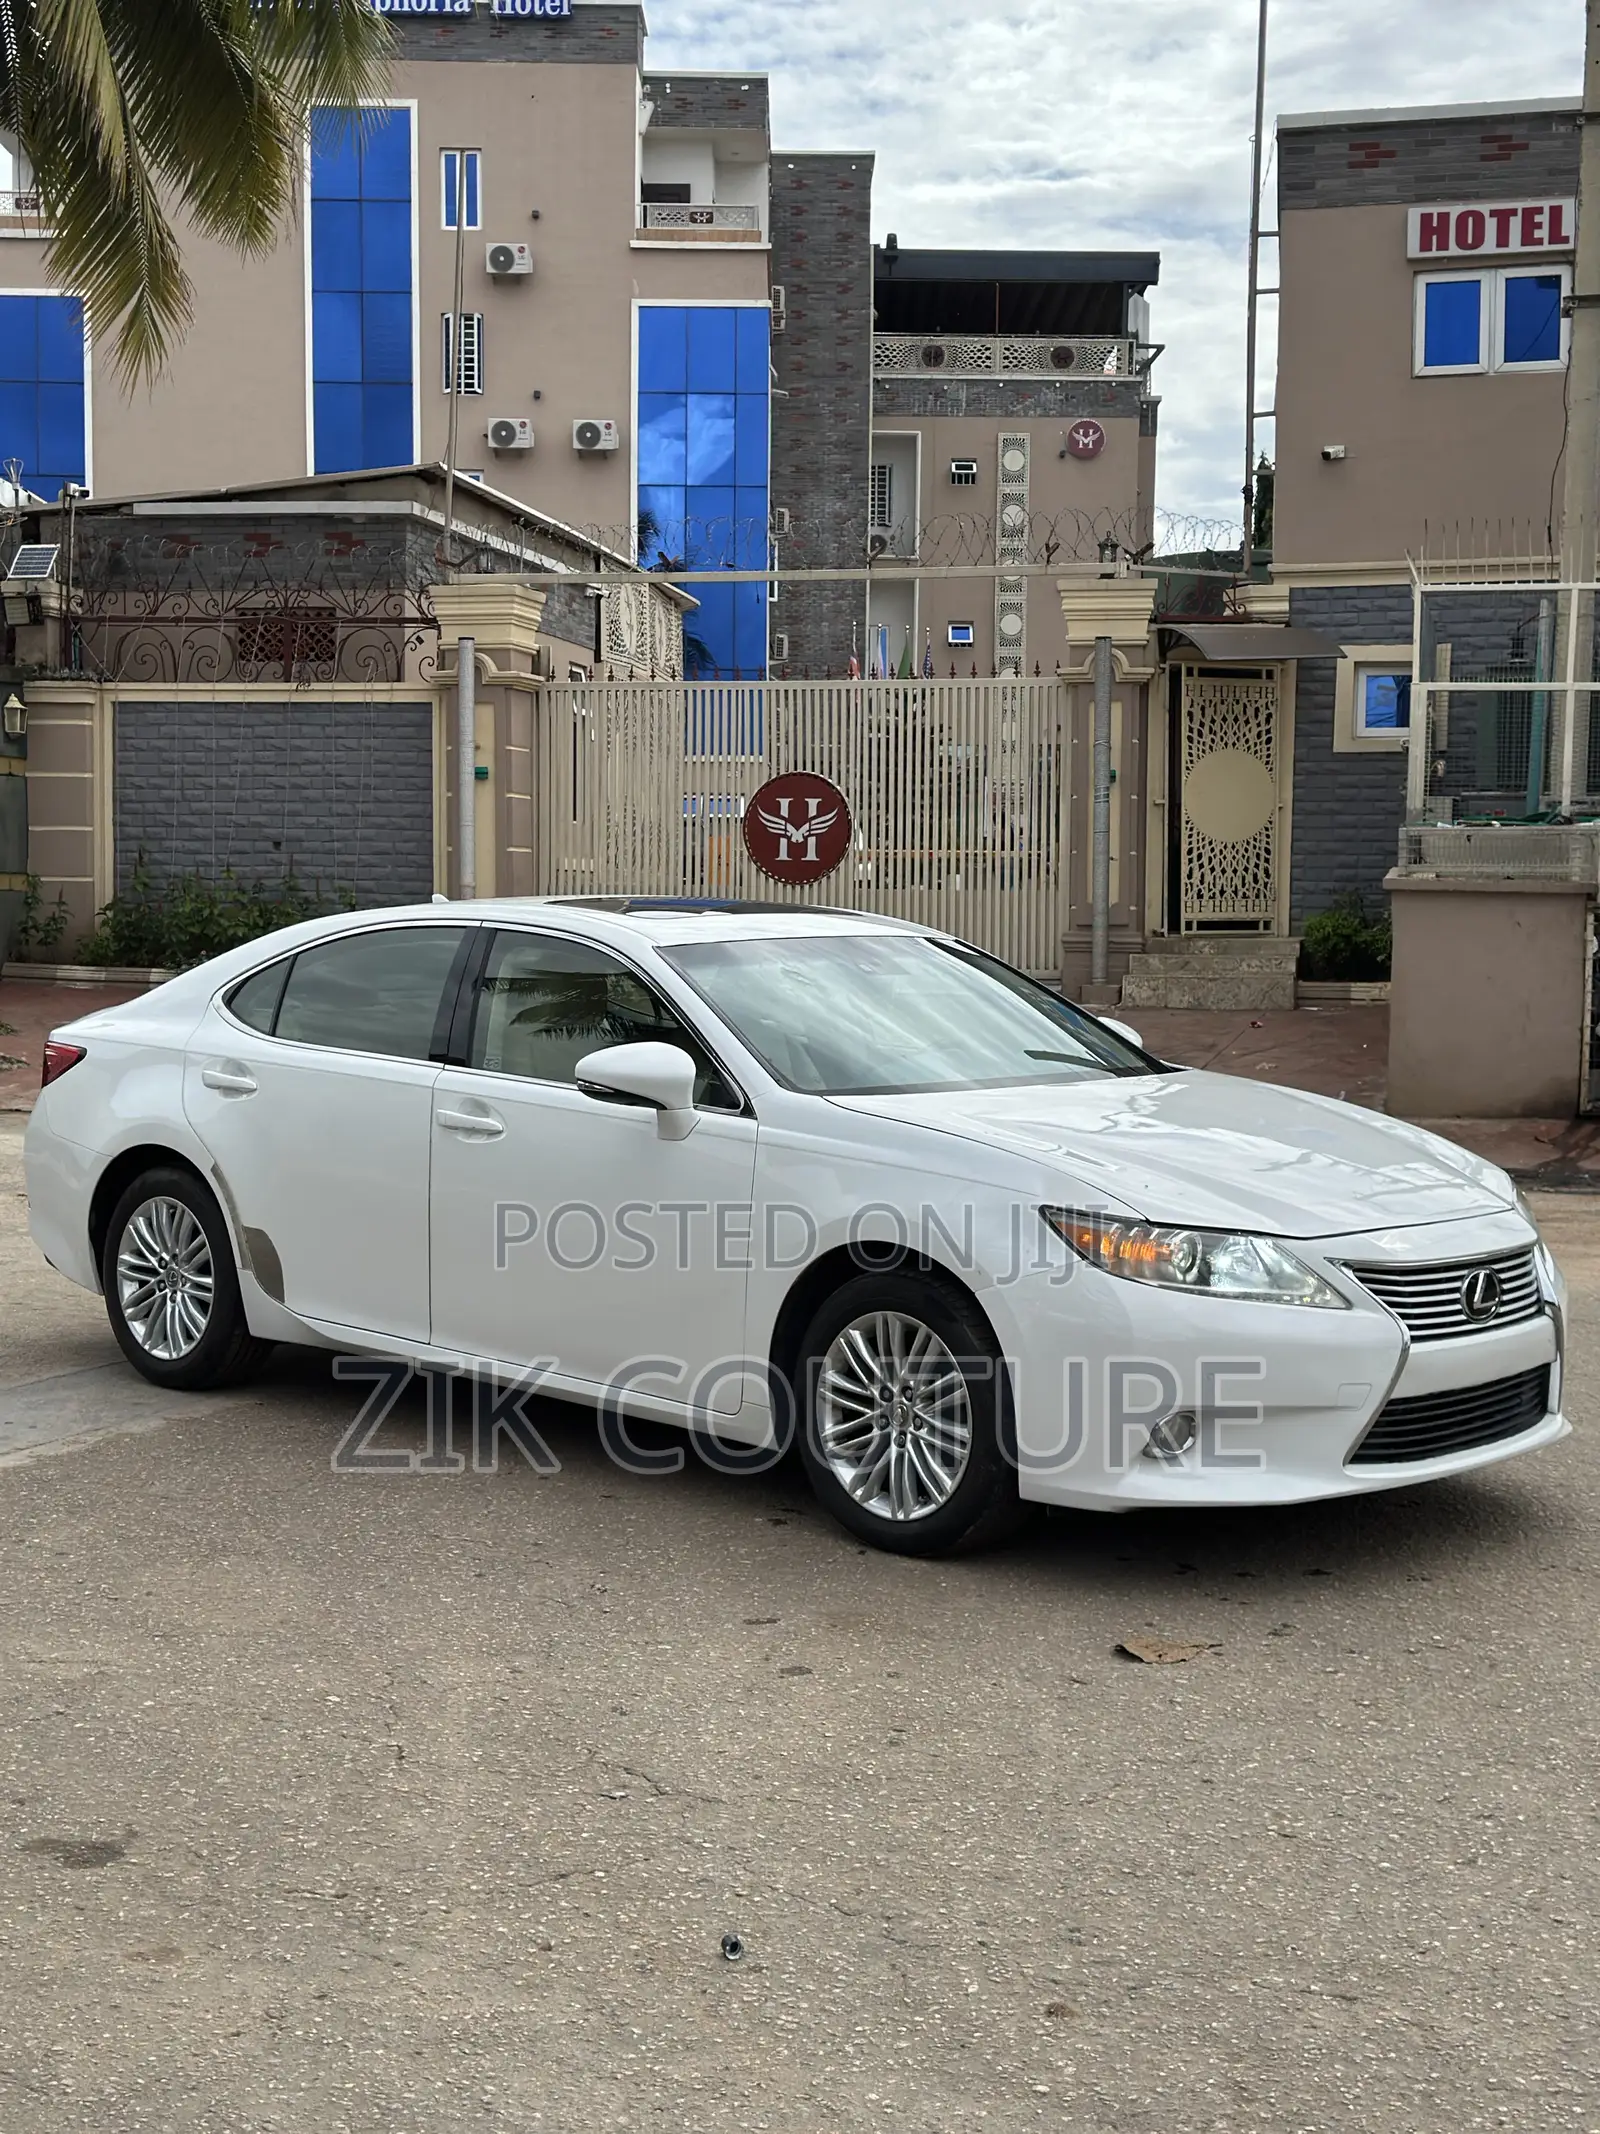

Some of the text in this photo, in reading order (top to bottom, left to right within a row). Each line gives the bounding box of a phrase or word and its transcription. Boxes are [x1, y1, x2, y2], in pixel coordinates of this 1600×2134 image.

[364, 0, 571, 15] phoria Hotel
[1419, 205, 1570, 252] HOTEL
